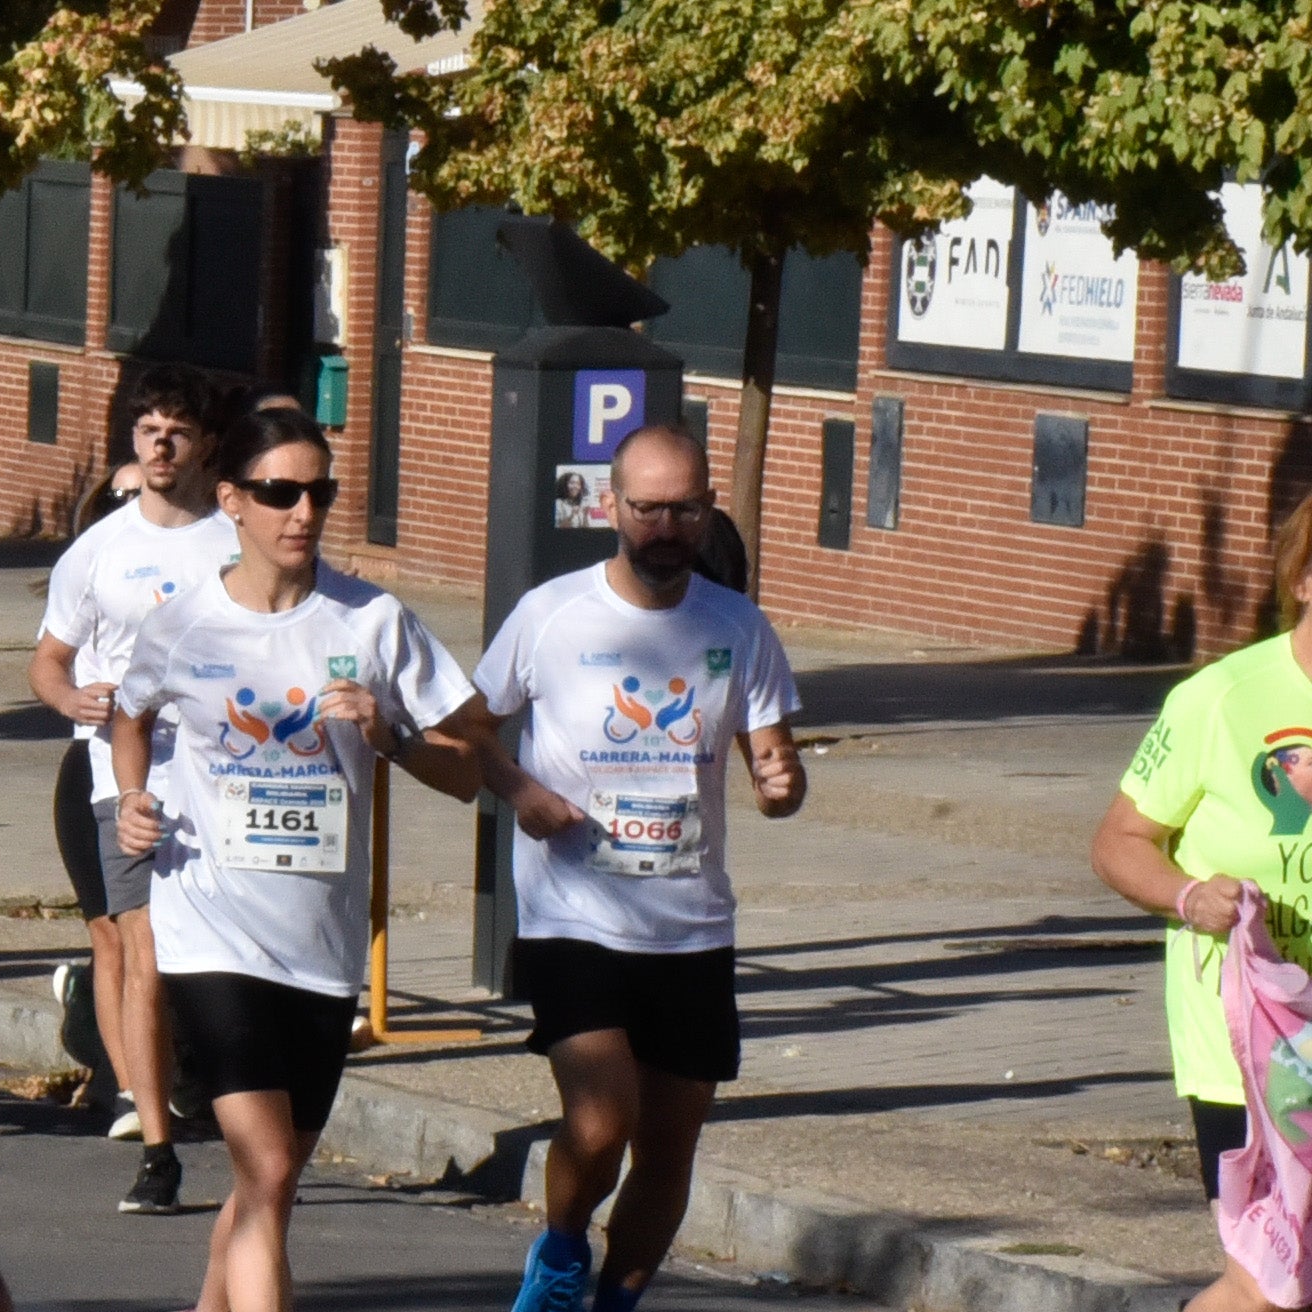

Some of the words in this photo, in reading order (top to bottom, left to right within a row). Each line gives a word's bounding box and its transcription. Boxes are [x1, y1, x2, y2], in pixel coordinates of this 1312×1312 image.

[1060, 274, 1124, 309] FEDHIELO
[589, 383, 632, 445] P
[245, 808, 319, 831] 1161
[1265, 891, 1312, 939] ALG
